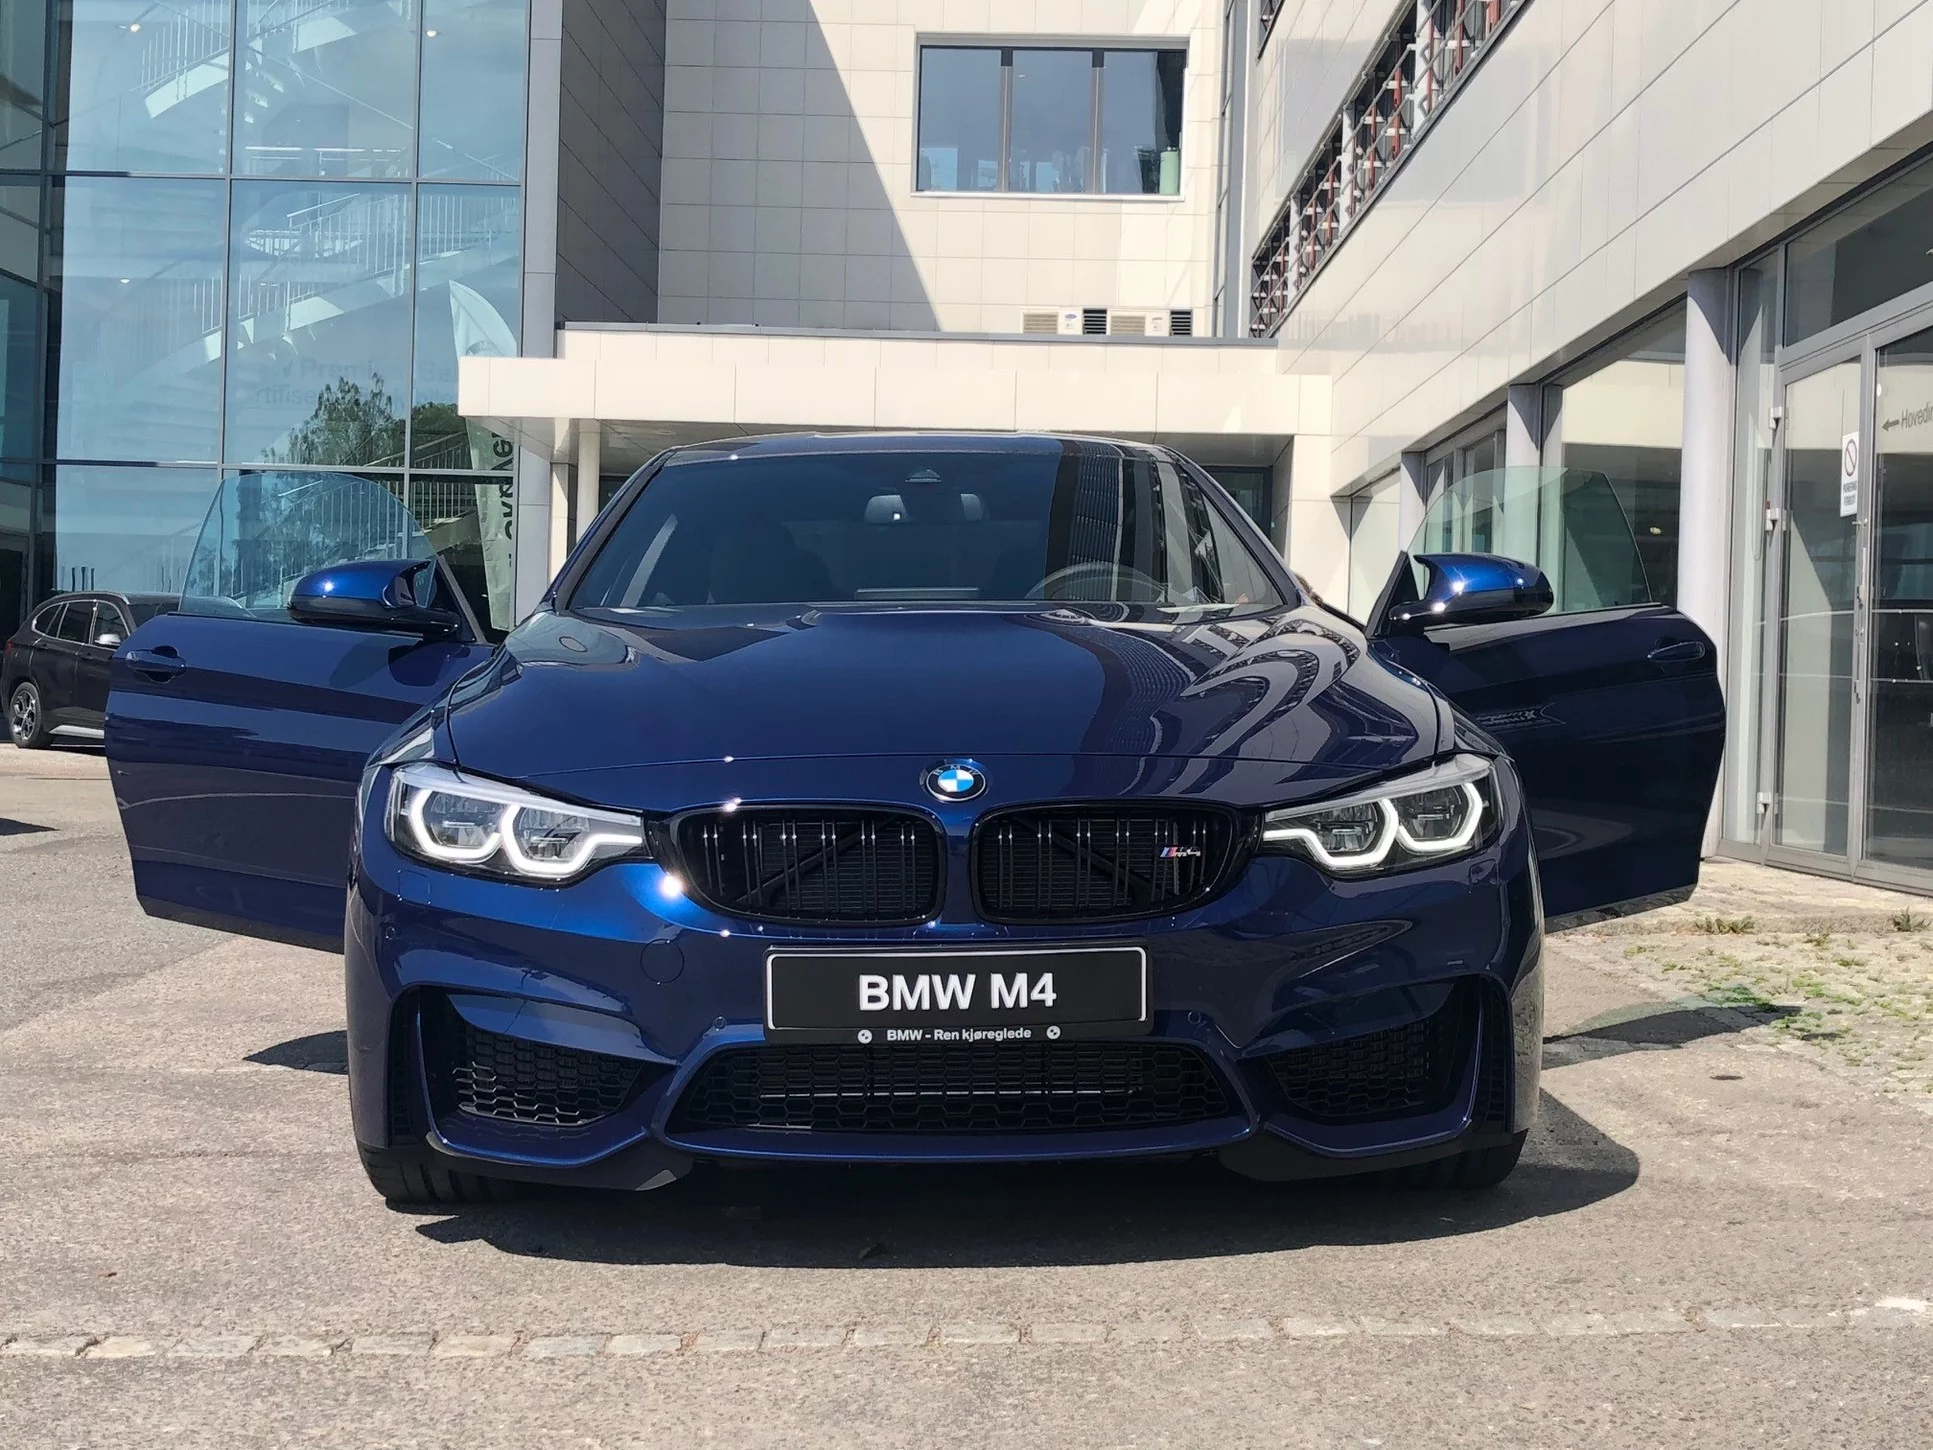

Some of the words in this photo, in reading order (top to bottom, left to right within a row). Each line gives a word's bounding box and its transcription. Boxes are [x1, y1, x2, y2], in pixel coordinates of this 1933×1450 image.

[858, 973, 977, 1011] BMW
[990, 972, 1057, 1009] M4
[886, 1029, 923, 1041] BMW
[933, 1028, 960, 1041] Ren
[961, 1026, 1032, 1043] kjøreglede
